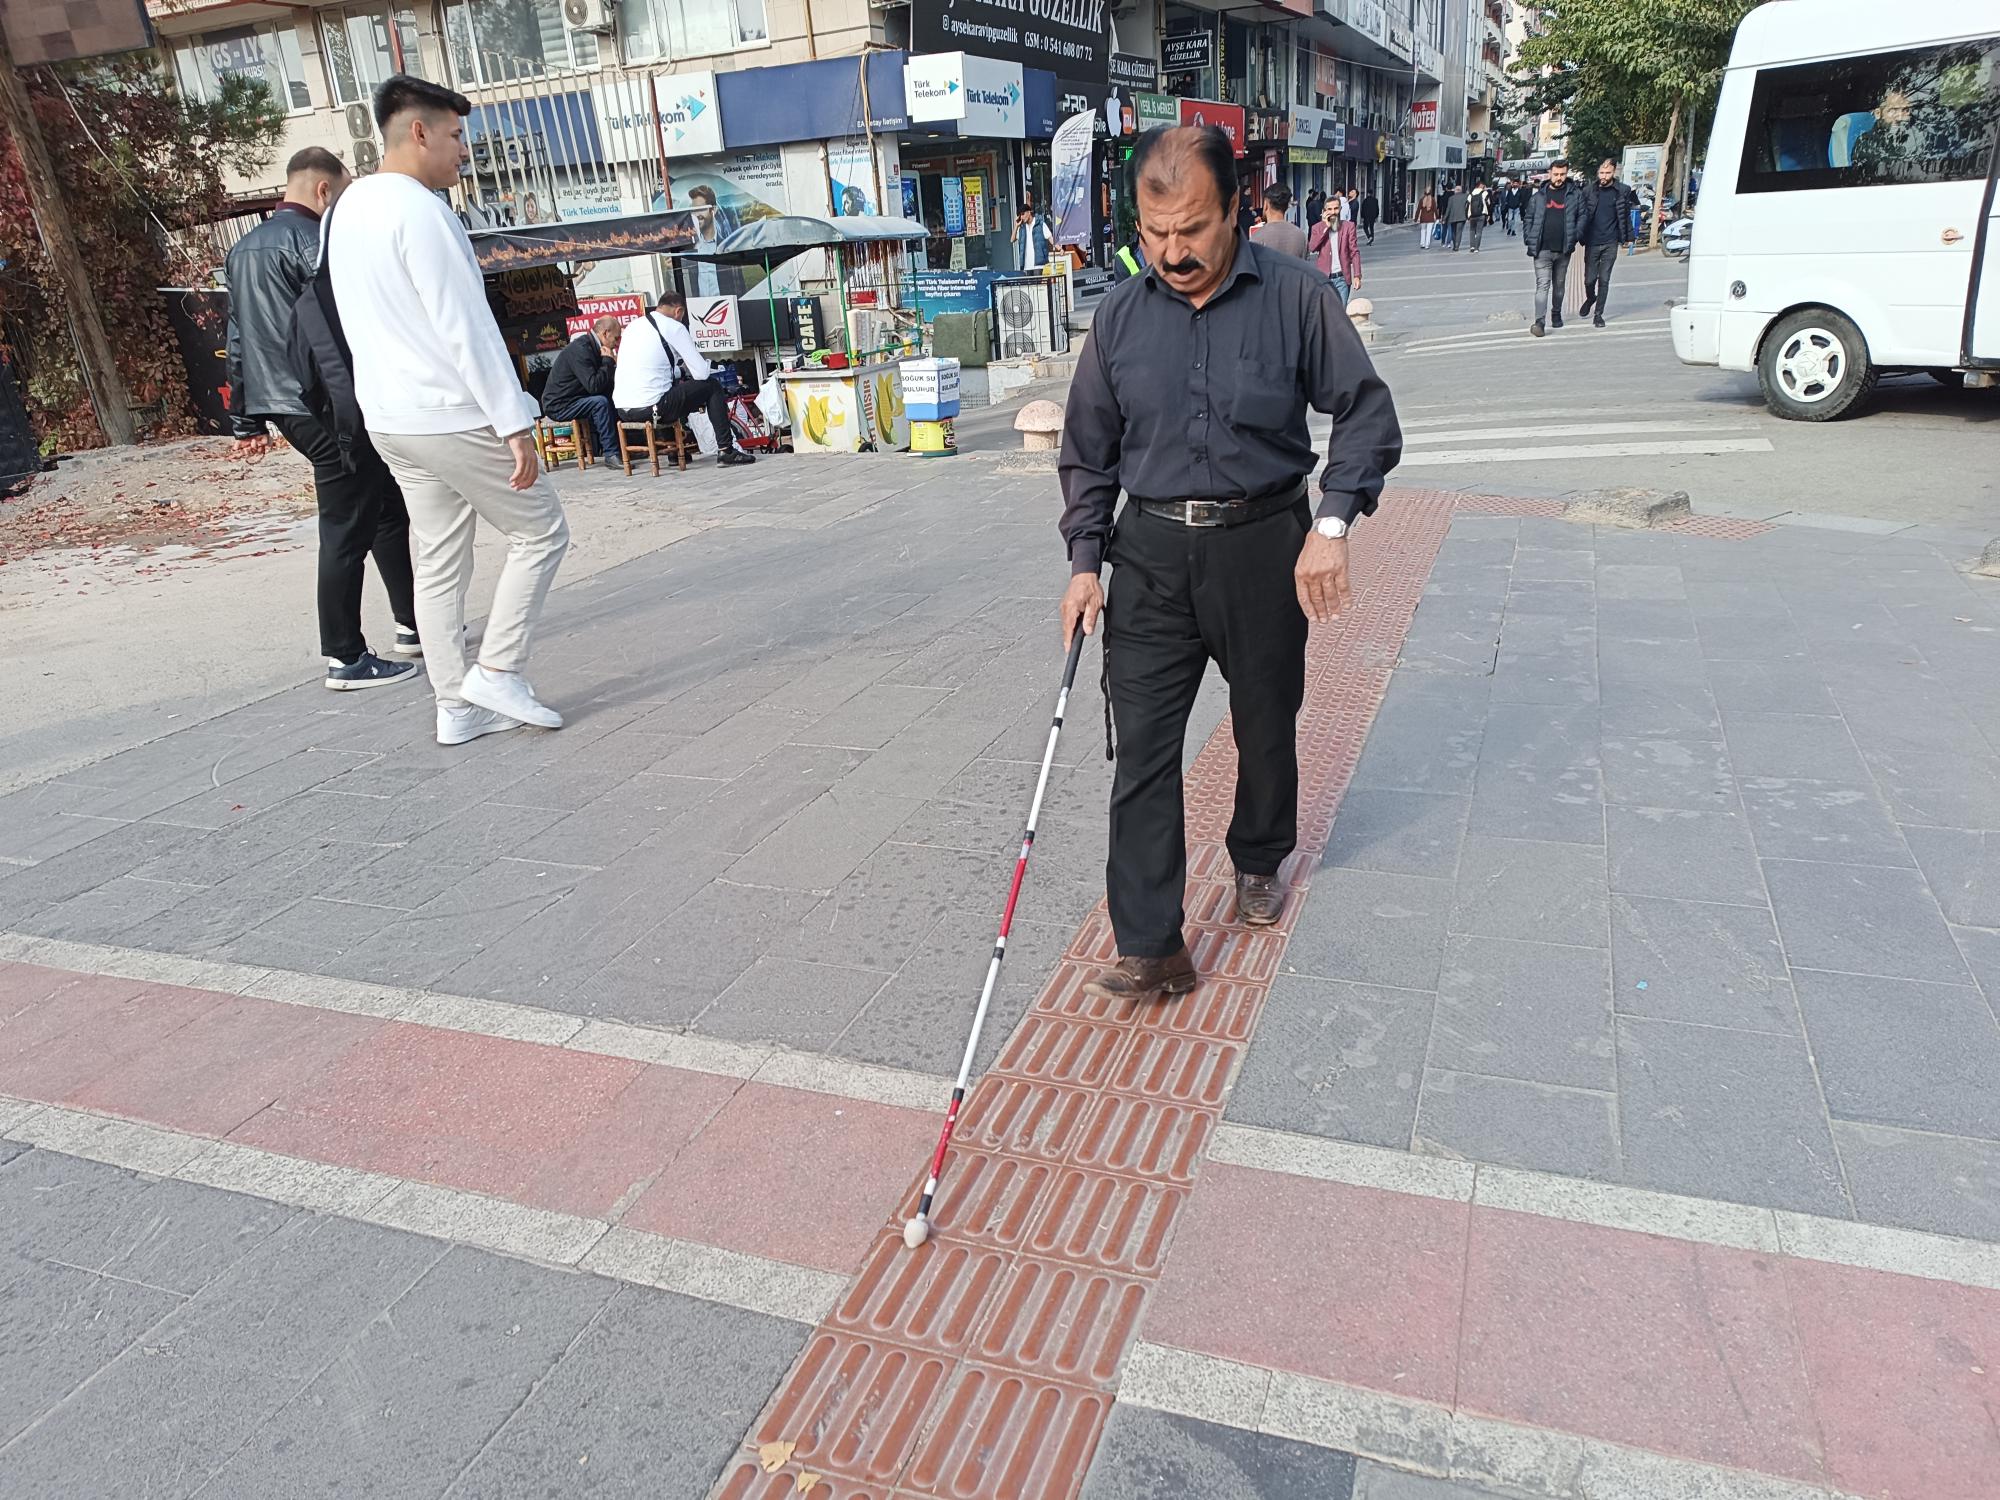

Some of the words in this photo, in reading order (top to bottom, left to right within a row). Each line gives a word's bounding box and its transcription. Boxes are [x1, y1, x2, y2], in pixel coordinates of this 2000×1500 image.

[951, 18, 1018, 43] aysekaravipguzellik
[1025, 31, 1040, 49] GSM
[1050, 37, 1062, 55] 541
[1063, 41, 1075, 57] 608
[1076, 45, 1084, 60] 07
[1085, 47, 1093, 61] 72
[1165, 41, 1185, 54] AYŞE
[1186, 38, 1208, 50] KARA
[1170, 50, 1201, 61] GÜZELLİK
[1117, 60, 1131, 74] KARA
[913, 80, 930, 89] Türk
[914, 88, 947, 99] Telekom
[966, 88, 981, 103] Türk
[982, 90, 1009, 106] Telekom
[1411, 110, 1436, 128] NOTER
[577, 298, 638, 315] MPANYA
[695, 328, 731, 339] GLOBAL
[797, 304, 817, 351] CAFE
[695, 340, 710, 349] NET
[713, 339, 735, 348] CAFE
